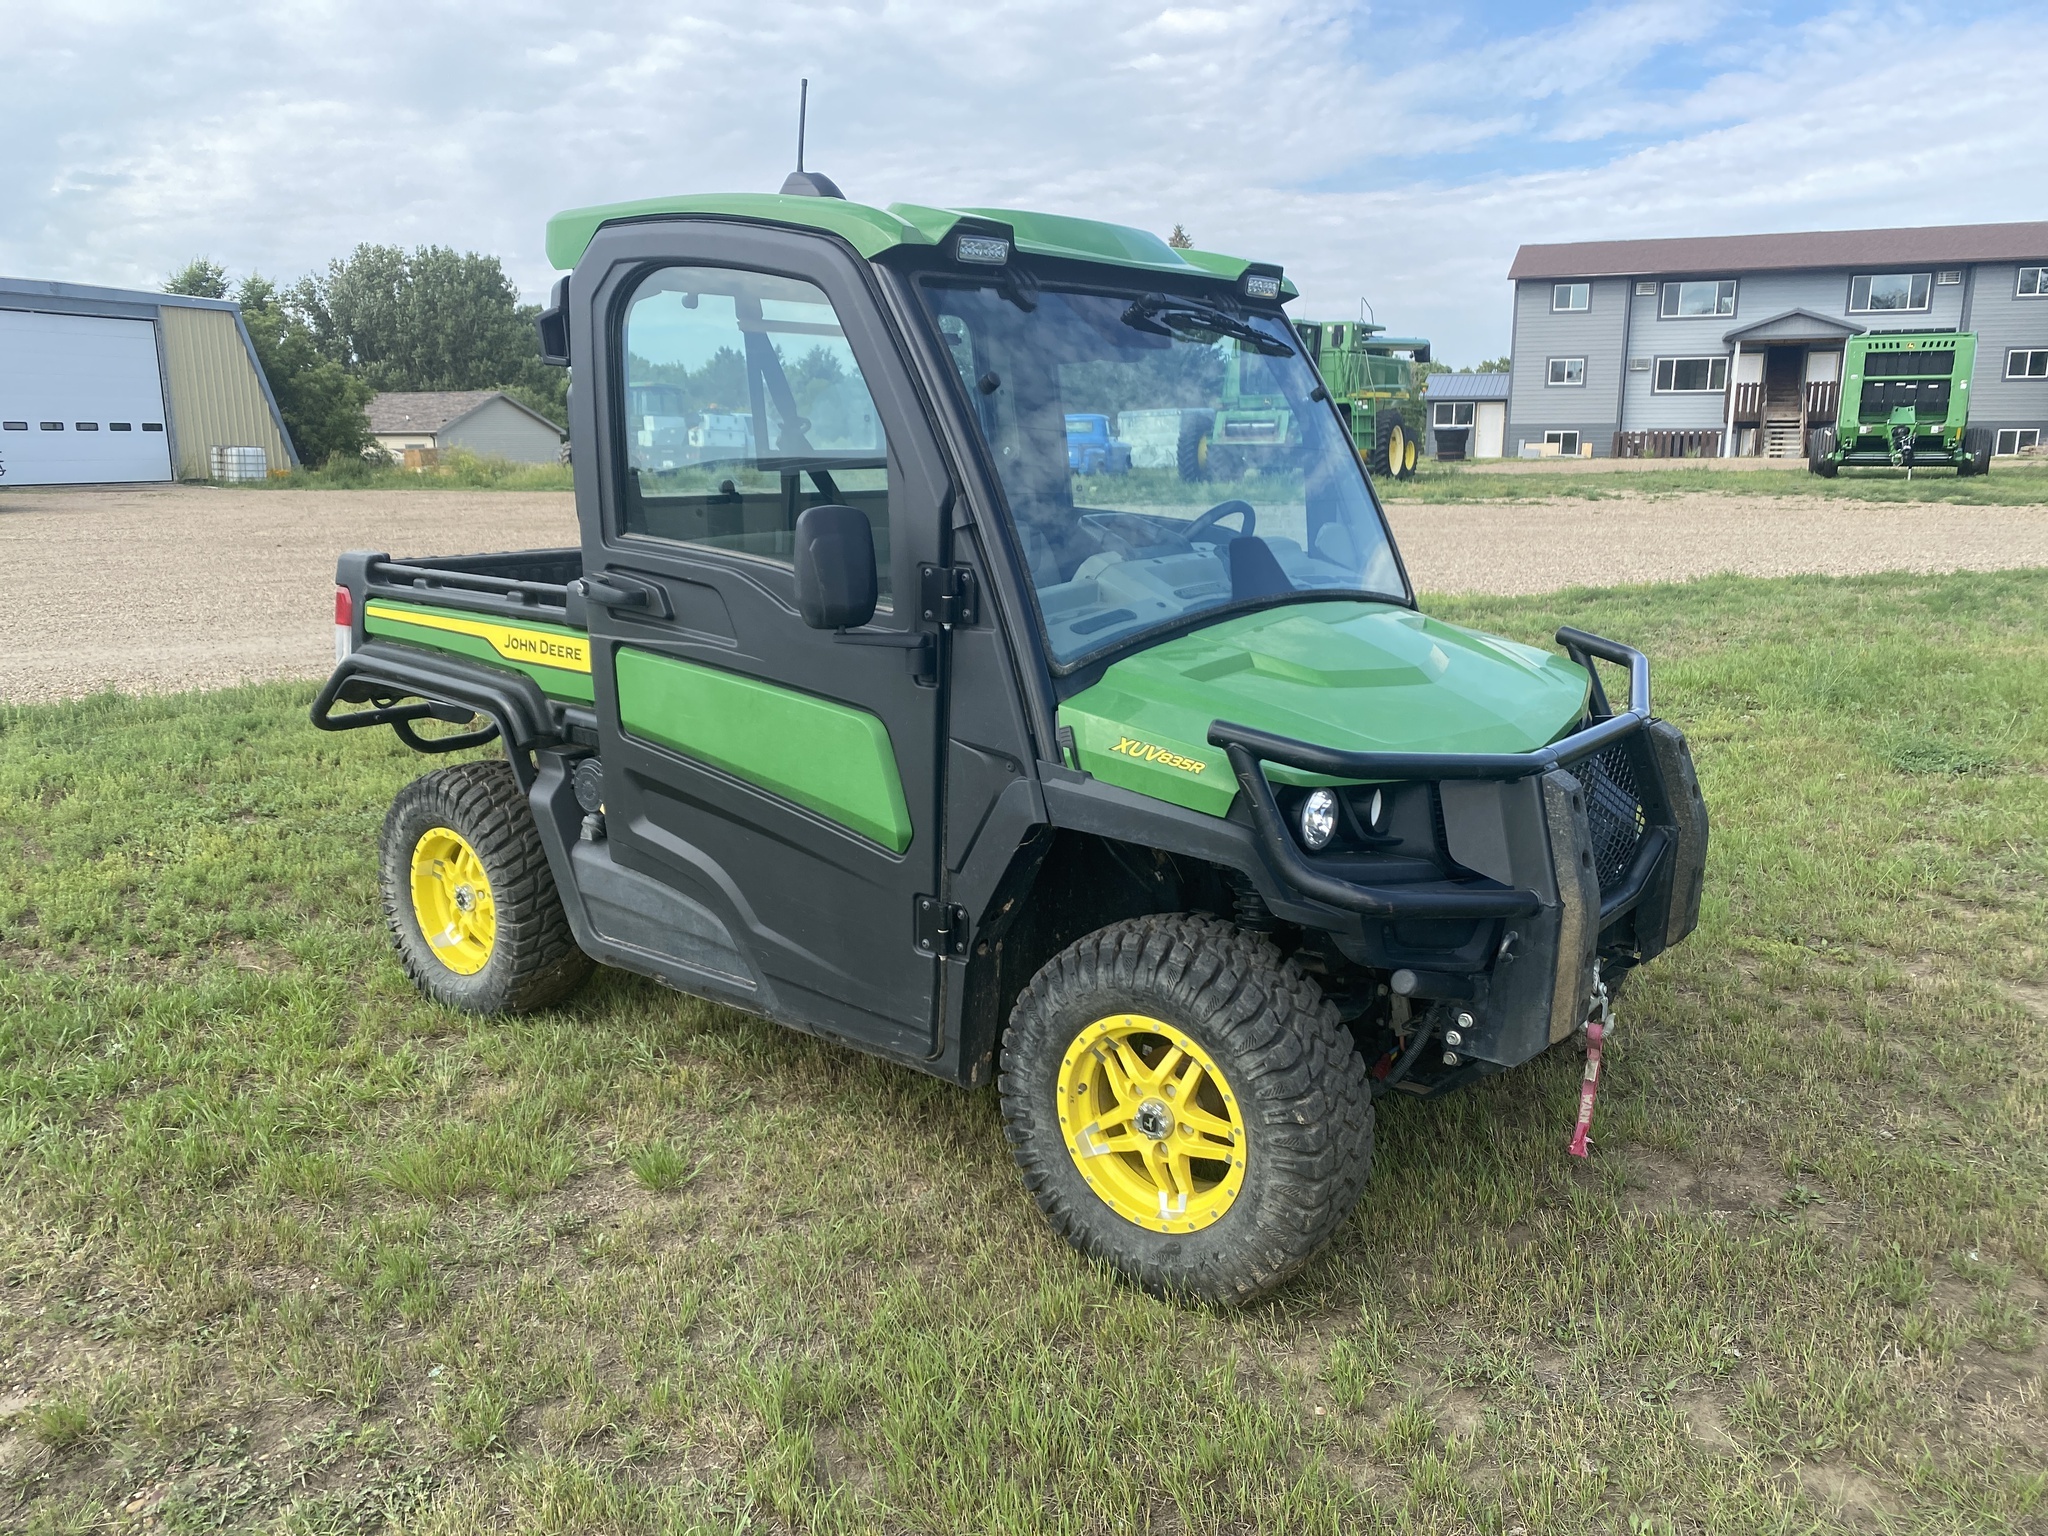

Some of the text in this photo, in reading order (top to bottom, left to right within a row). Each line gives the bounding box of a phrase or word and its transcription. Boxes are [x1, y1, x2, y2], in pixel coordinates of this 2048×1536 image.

[504, 633, 582, 661] JOHN DEERE
[1109, 736, 1206, 775] XUV835R
[1579, 1093, 1593, 1123] WARN
